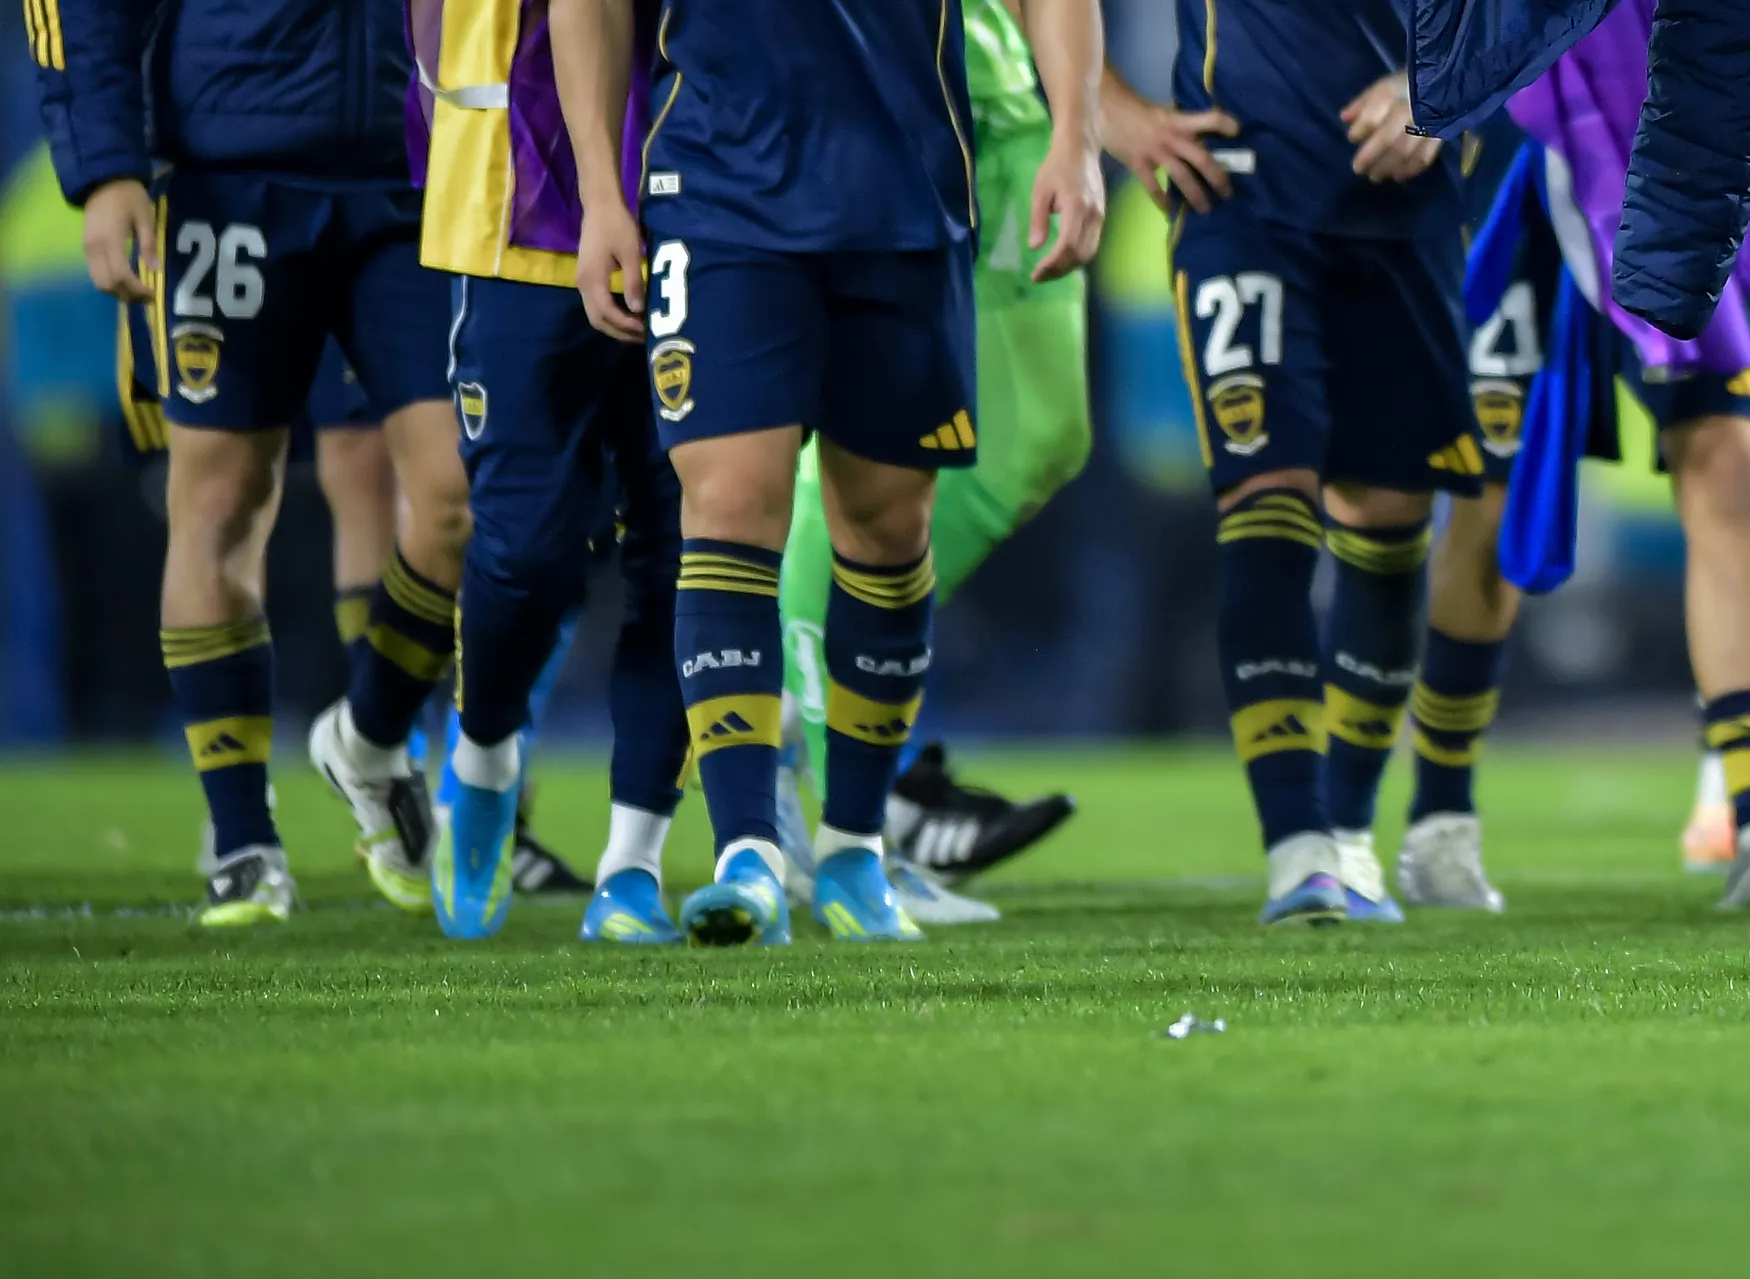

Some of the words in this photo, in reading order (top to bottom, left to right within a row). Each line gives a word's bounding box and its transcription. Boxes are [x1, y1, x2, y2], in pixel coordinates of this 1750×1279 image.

[173, 222, 268, 320] 26
[649, 239, 690, 338] 3
[1195, 271, 1285, 376] 27
